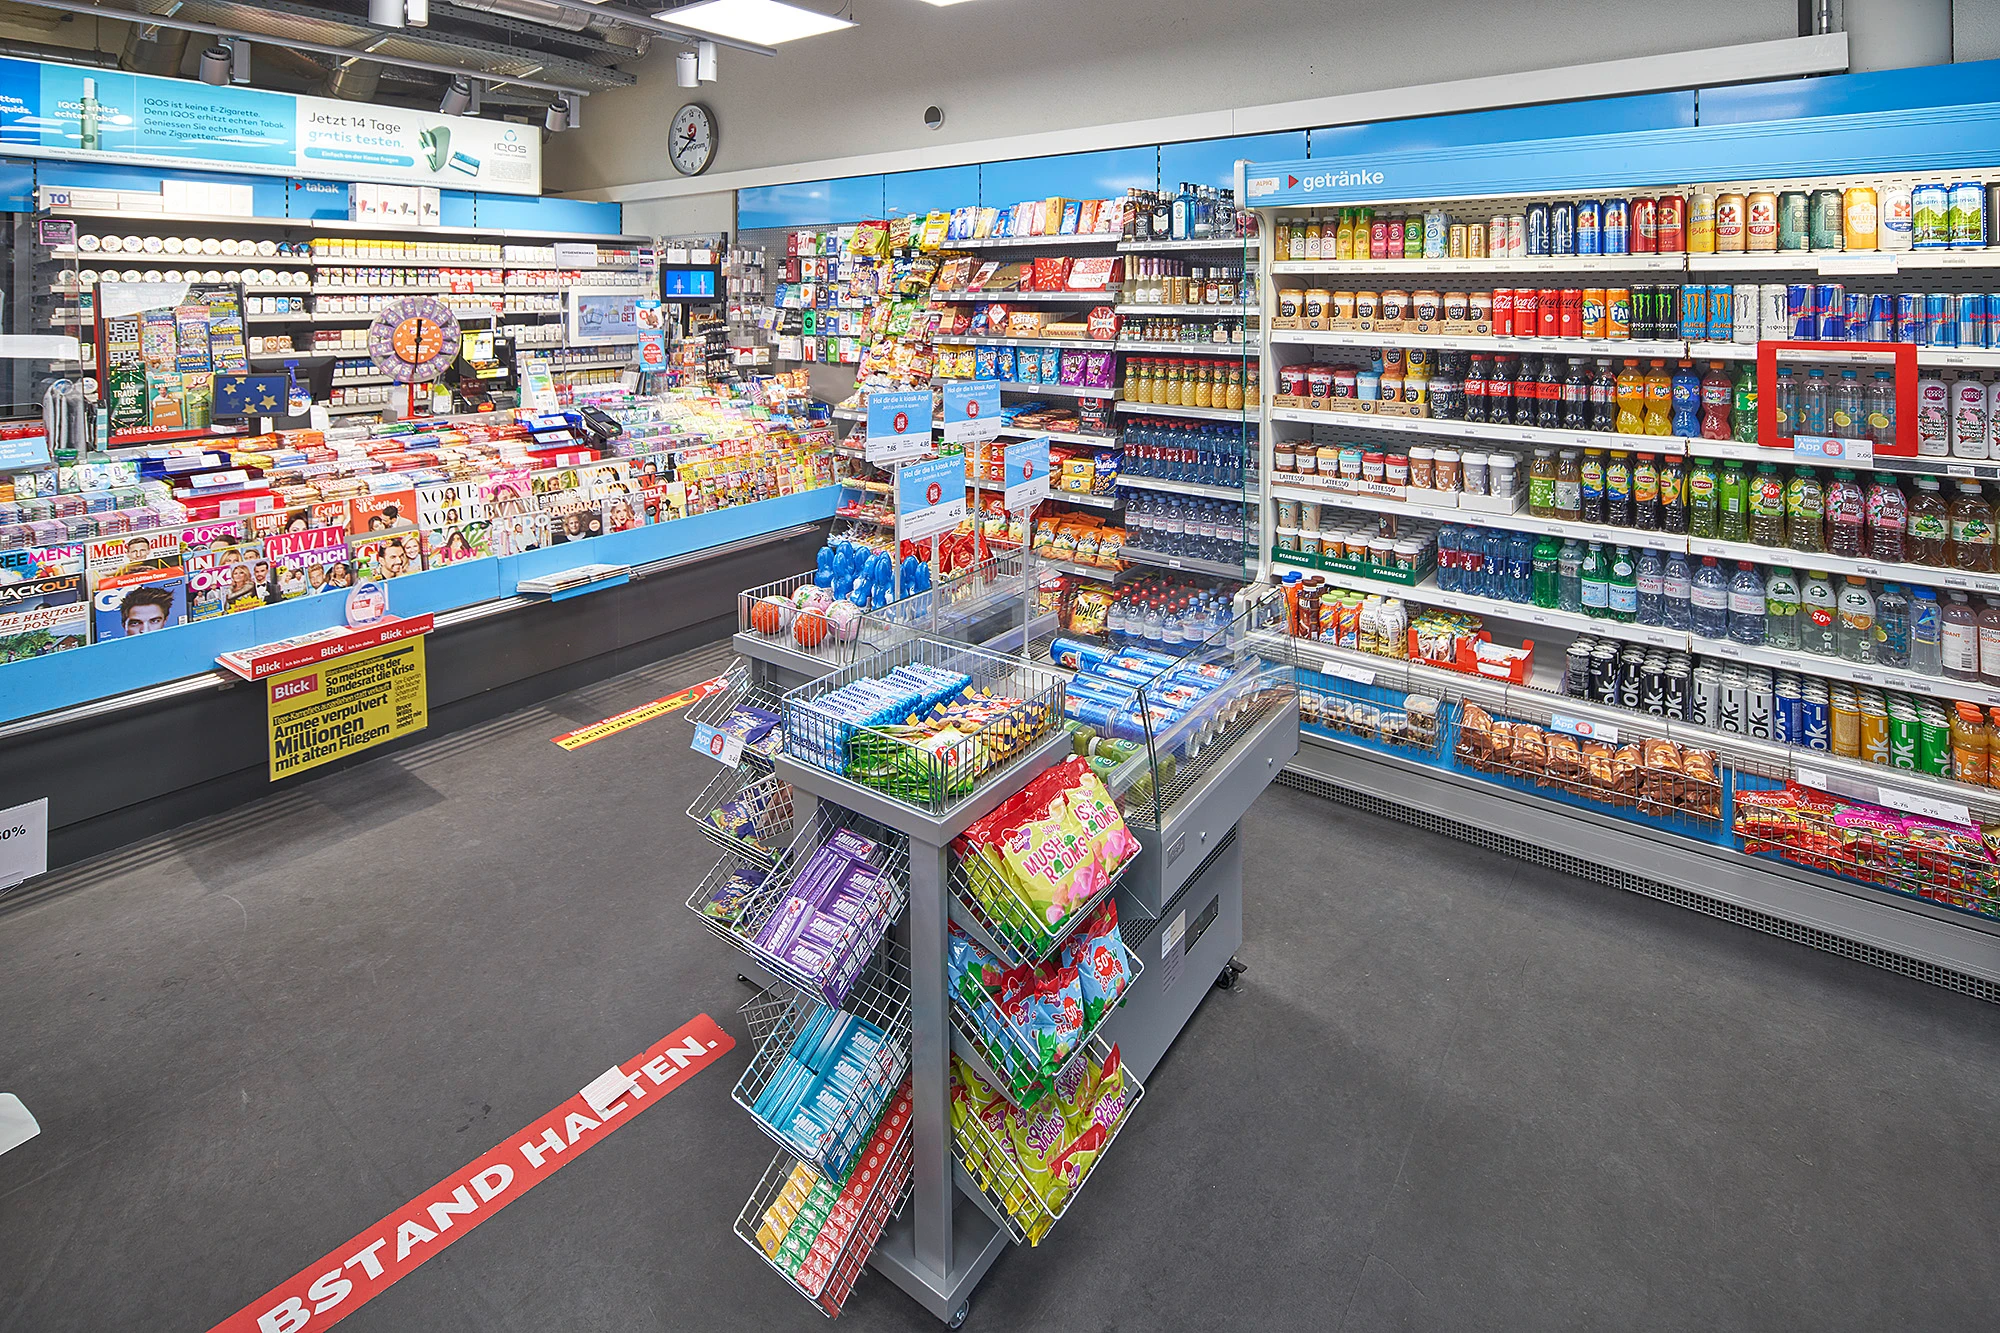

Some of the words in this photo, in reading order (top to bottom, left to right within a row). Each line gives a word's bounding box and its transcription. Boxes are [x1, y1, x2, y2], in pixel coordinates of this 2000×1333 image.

[54, 110, 86, 119] echten
[57, 101, 84, 111] IQOS
[86, 104, 119, 114] erhitzt
[143, 98, 169, 108] IQOS
[171, 101, 183, 109] ist
[185, 102, 208, 111] keine
[210, 105, 260, 118] E-Zigarette.
[143, 108, 168, 117] Denn
[170, 109, 195, 120] IQOS
[197, 112, 226, 122] erhitzt
[228, 116, 258, 126] echten
[260, 119, 287, 130] Tabak.
[309, 112, 347, 127] Jetzt
[351, 117, 366, 128] 14
[369, 119, 401, 134] Tage
[143, 117, 191, 130] Geniessen
[192, 122, 206, 131] Sie
[208, 124, 238, 134] echten
[241, 127, 265, 137] Tabak
[143, 127, 166, 137] ohne
[356, 133, 404, 149] testen.
[494, 143, 527, 154] IQOS
[306, 182, 339, 194] tabak
[1303, 170, 1385, 192] getränke
[1801, 305, 1815, 313] Bull
[1828, 305, 1843, 313] Bull
[120, 381, 136, 390] DAS
[112, 389, 144, 398] TRAUM-
[121, 397, 136, 406] LOS
[116, 424, 168, 436] SWISSLOS
[1797, 441, 1821, 453] App
[904, 470, 913, 478] Hol
[421, 484, 479, 505] VOUE
[1367, 483, 1396, 493] LATTESSO
[1762, 485, 1780, 496] 50%
[314, 503, 343, 517] Gala
[422, 505, 481, 526] VOUE
[546, 500, 601, 518] BARBARA
[256, 512, 288, 529] BUNTE
[267, 532, 344, 562] GRAZIA
[189, 556, 214, 572] IN
[1279, 553, 1309, 563] STARBUCKS
[1324, 560, 1357, 571] STARBUCKS
[192, 568, 233, 586] OK!
[1372, 568, 1407, 579] STARBUCKS
[1638, 581, 1659, 591] evian
[23, 604, 87, 623] HERITAGE
[1811, 612, 1832, 624] 50%
[23, 617, 58, 631] POST
[380, 629, 403, 642] Blick
[320, 644, 344, 658] Blick
[255, 660, 281, 675] Blick
[326, 676, 338, 687] So
[338, 662, 385, 683] meisterte
[385, 657, 402, 672] der
[326, 675, 376, 698] Bundesrat
[376, 671, 391, 684] die
[392, 662, 415, 679] Krise
[895, 669, 928, 686] mentos
[275, 679, 310, 700] Blick
[274, 719, 320, 740] Armee
[321, 693, 389, 723] verpulvert
[1554, 718, 1574, 729] App
[581, 716, 637, 741] SCHÜTZEN
[275, 716, 365, 759] Millionen
[695, 731, 711, 746] App
[275, 754, 300, 773] mit
[302, 743, 337, 764] alten
[339, 723, 390, 750] Fliegern
[1041, 823, 1062, 836] SOUR
[1845, 817, 1899, 831] HARIBO
[1022, 833, 1066, 878] MUSH
[1096, 952, 1112, 973] 50%
[1100, 1087, 1128, 1132] UCKERS
[1026, 1112, 1049, 1149] SOUR
[1031, 1108, 1066, 1161] SUCKERS
